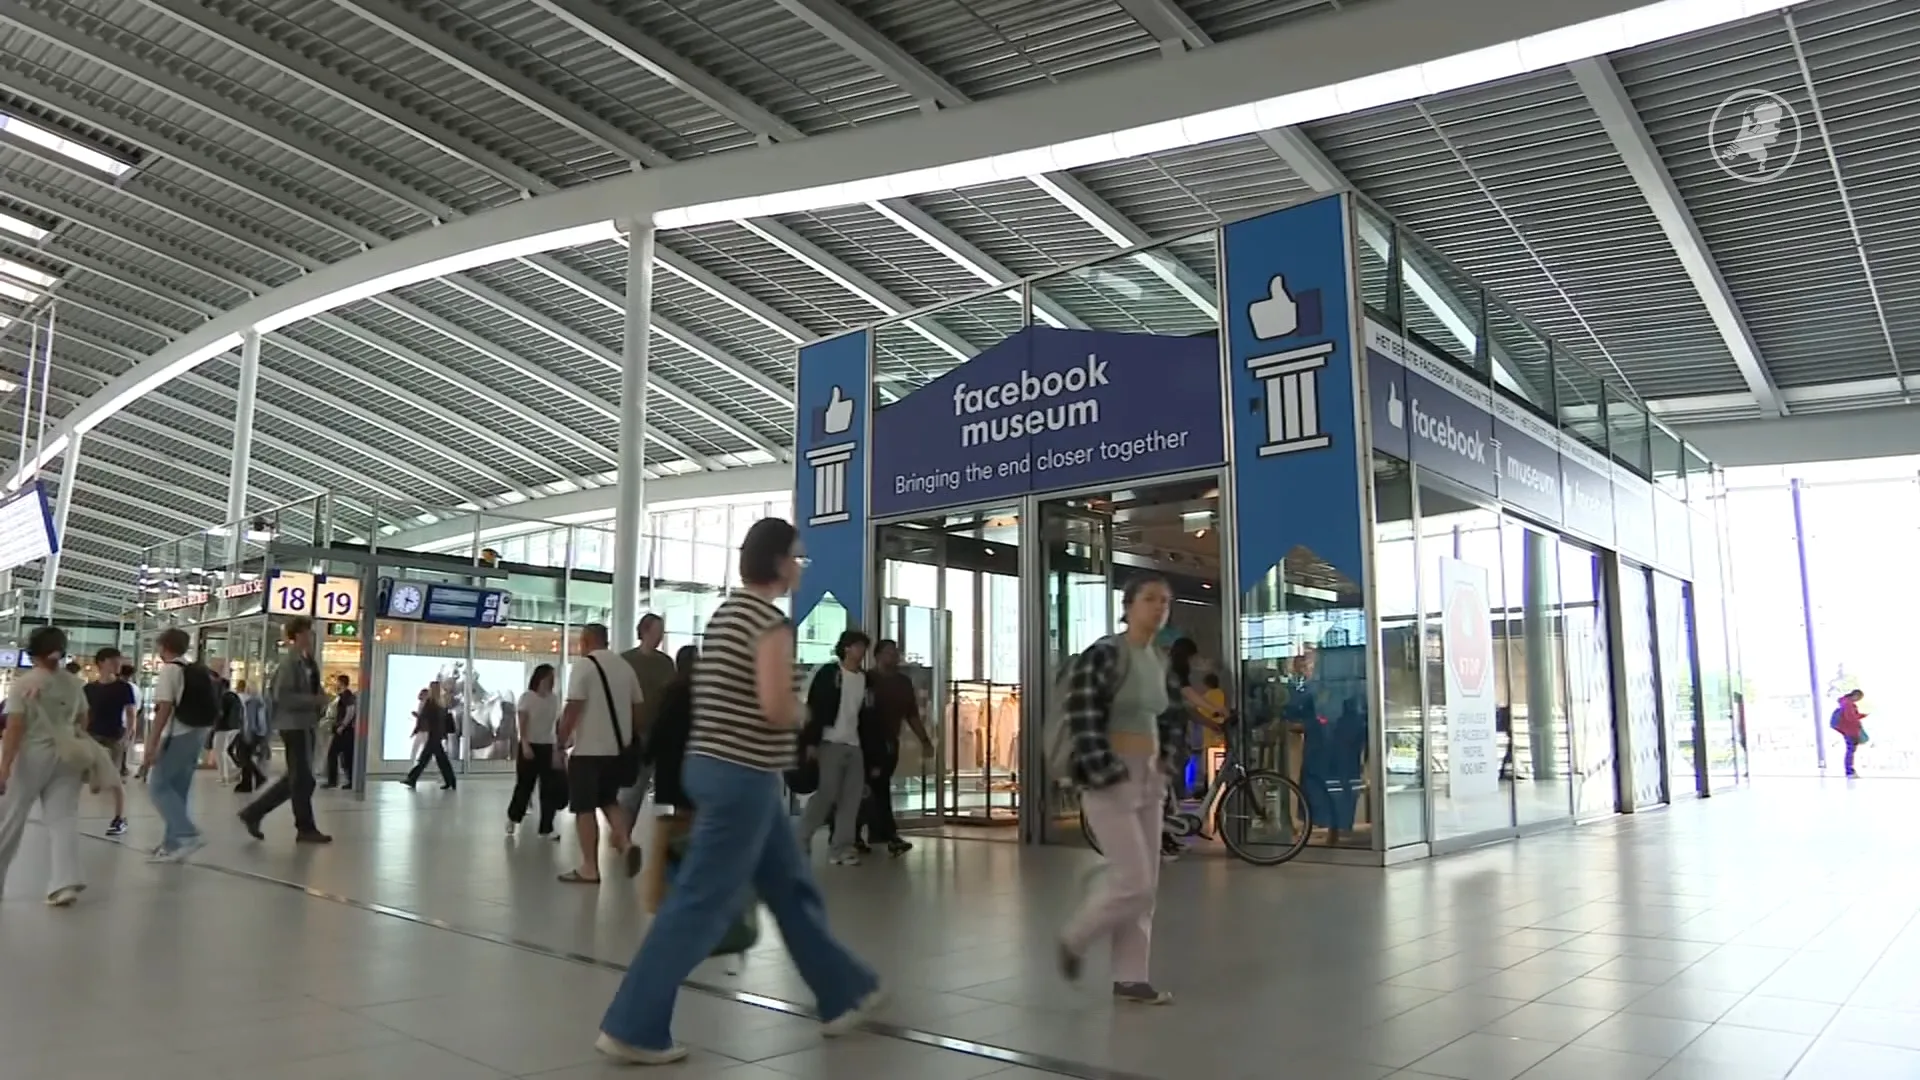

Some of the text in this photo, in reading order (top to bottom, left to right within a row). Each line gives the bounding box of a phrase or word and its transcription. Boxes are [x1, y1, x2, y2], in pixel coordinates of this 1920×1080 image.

[953, 353, 1109, 416] facebook
[961, 398, 1099, 447] museum
[1411, 398, 1485, 464] facebook
[1507, 455, 1556, 493] museum
[895, 429, 1189, 495] Bringing the end closer together
[277, 586, 305, 611] 18
[324, 591, 352, 615] 19
[1459, 656, 1480, 676] STOP
